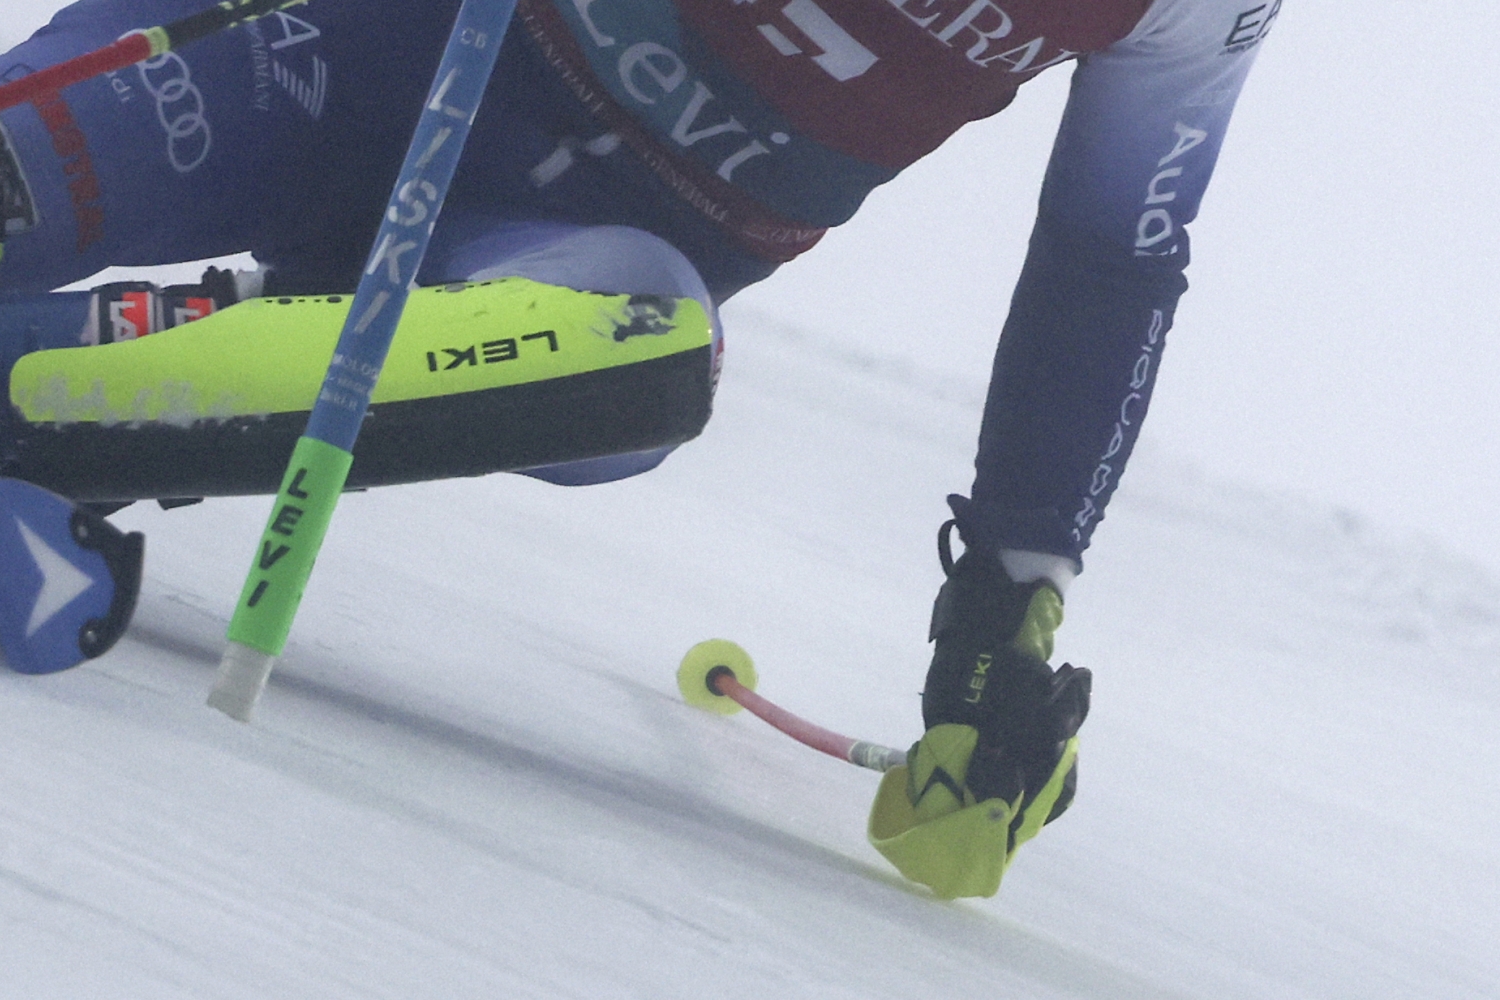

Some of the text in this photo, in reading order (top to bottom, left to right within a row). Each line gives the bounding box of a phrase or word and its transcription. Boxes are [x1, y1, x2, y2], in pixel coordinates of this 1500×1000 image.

[427, 329, 560, 373] LEKI
[247, 467, 309, 608] LEVI
[964, 652, 993, 704] LEKI
